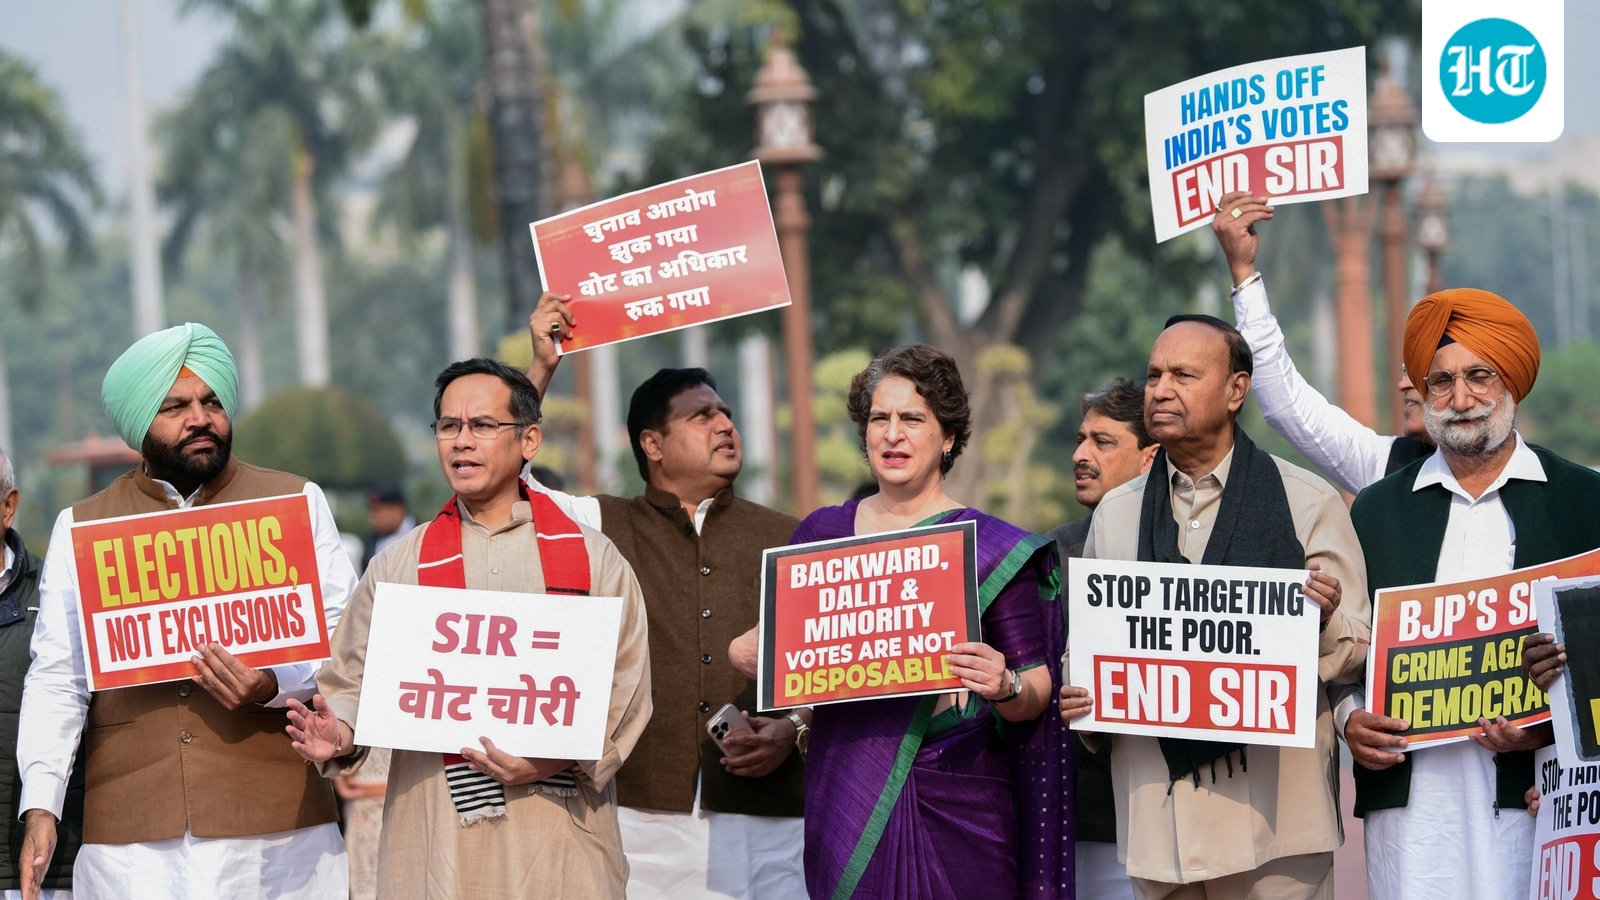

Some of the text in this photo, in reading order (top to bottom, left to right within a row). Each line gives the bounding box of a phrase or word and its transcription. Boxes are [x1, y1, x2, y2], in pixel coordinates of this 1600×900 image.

[1180, 65, 1325, 126] HANDS OFF
[1164, 99, 1349, 171] INDIA’S VOTES
[1176, 141, 1340, 223] END SIR
[582, 188, 717, 243] चुनाव आयोग
[608, 224, 698, 264] झुक गया
[578, 245, 748, 296] वोट का अधिकार
[624, 286, 711, 321] रुक गया
[93, 515, 298, 608] ELECTIONS,
[790, 544, 949, 589] BACKWARD,
[818, 578, 919, 613] DALIT &
[1086, 573, 1304, 617] STOP TARGETING
[1398, 575, 1558, 642] BJP’S SI
[105, 592, 306, 662] NOT EXCLUSIONS
[431, 612, 561, 657] SIR =
[804, 602, 934, 643] MINORITY
[1126, 615, 1261, 655] THE POOR.
[785, 631, 956, 671] VOTES ARE NOT
[1391, 645, 1473, 684] CRIME
[398, 668, 581, 726] वोट चोरी
[1099, 660, 1290, 730] END SIR
[1553, 790, 1600, 831] THE PO
[1540, 841, 1580, 900] END
